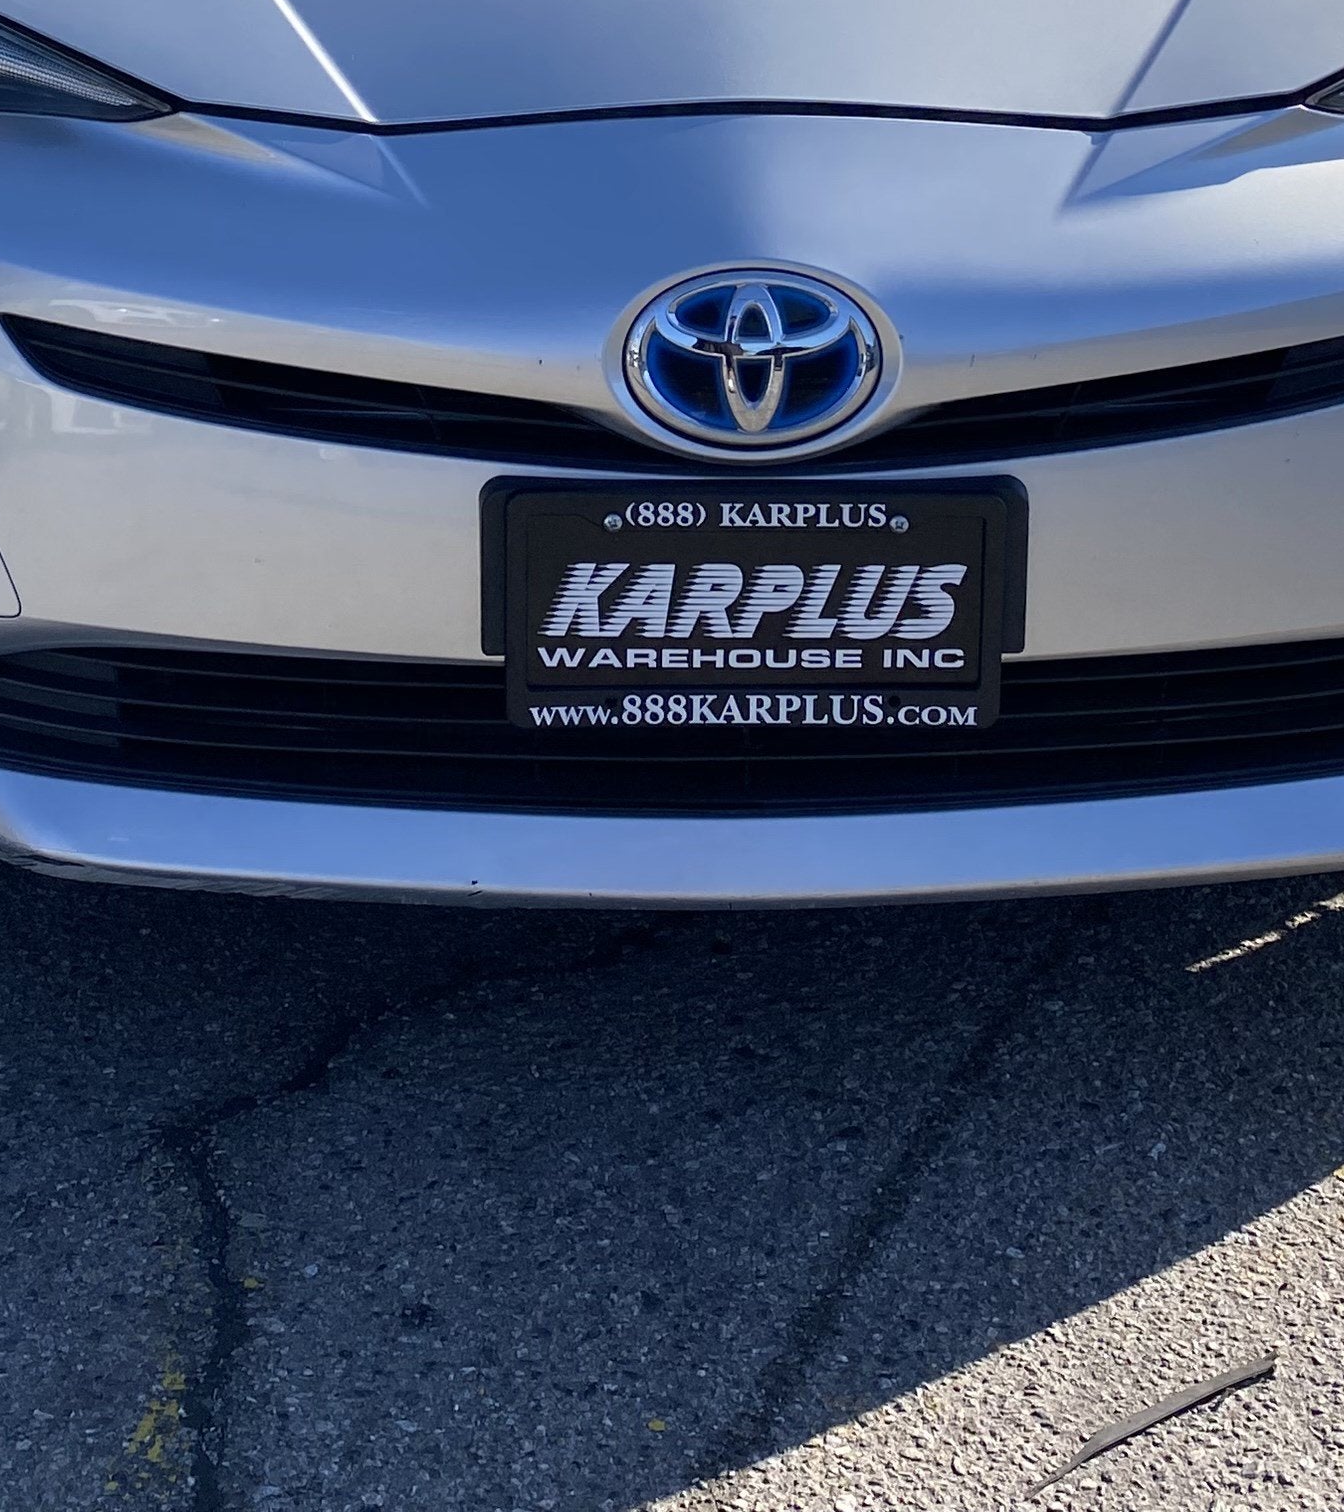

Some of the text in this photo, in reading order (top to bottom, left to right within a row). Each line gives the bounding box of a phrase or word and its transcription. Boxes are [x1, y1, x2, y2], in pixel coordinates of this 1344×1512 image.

[624, 501, 887, 529] (888) KARPLUS
[537, 562, 968, 641] KARPLUS
[537, 647, 966, 670] WAREHOUSE INC
